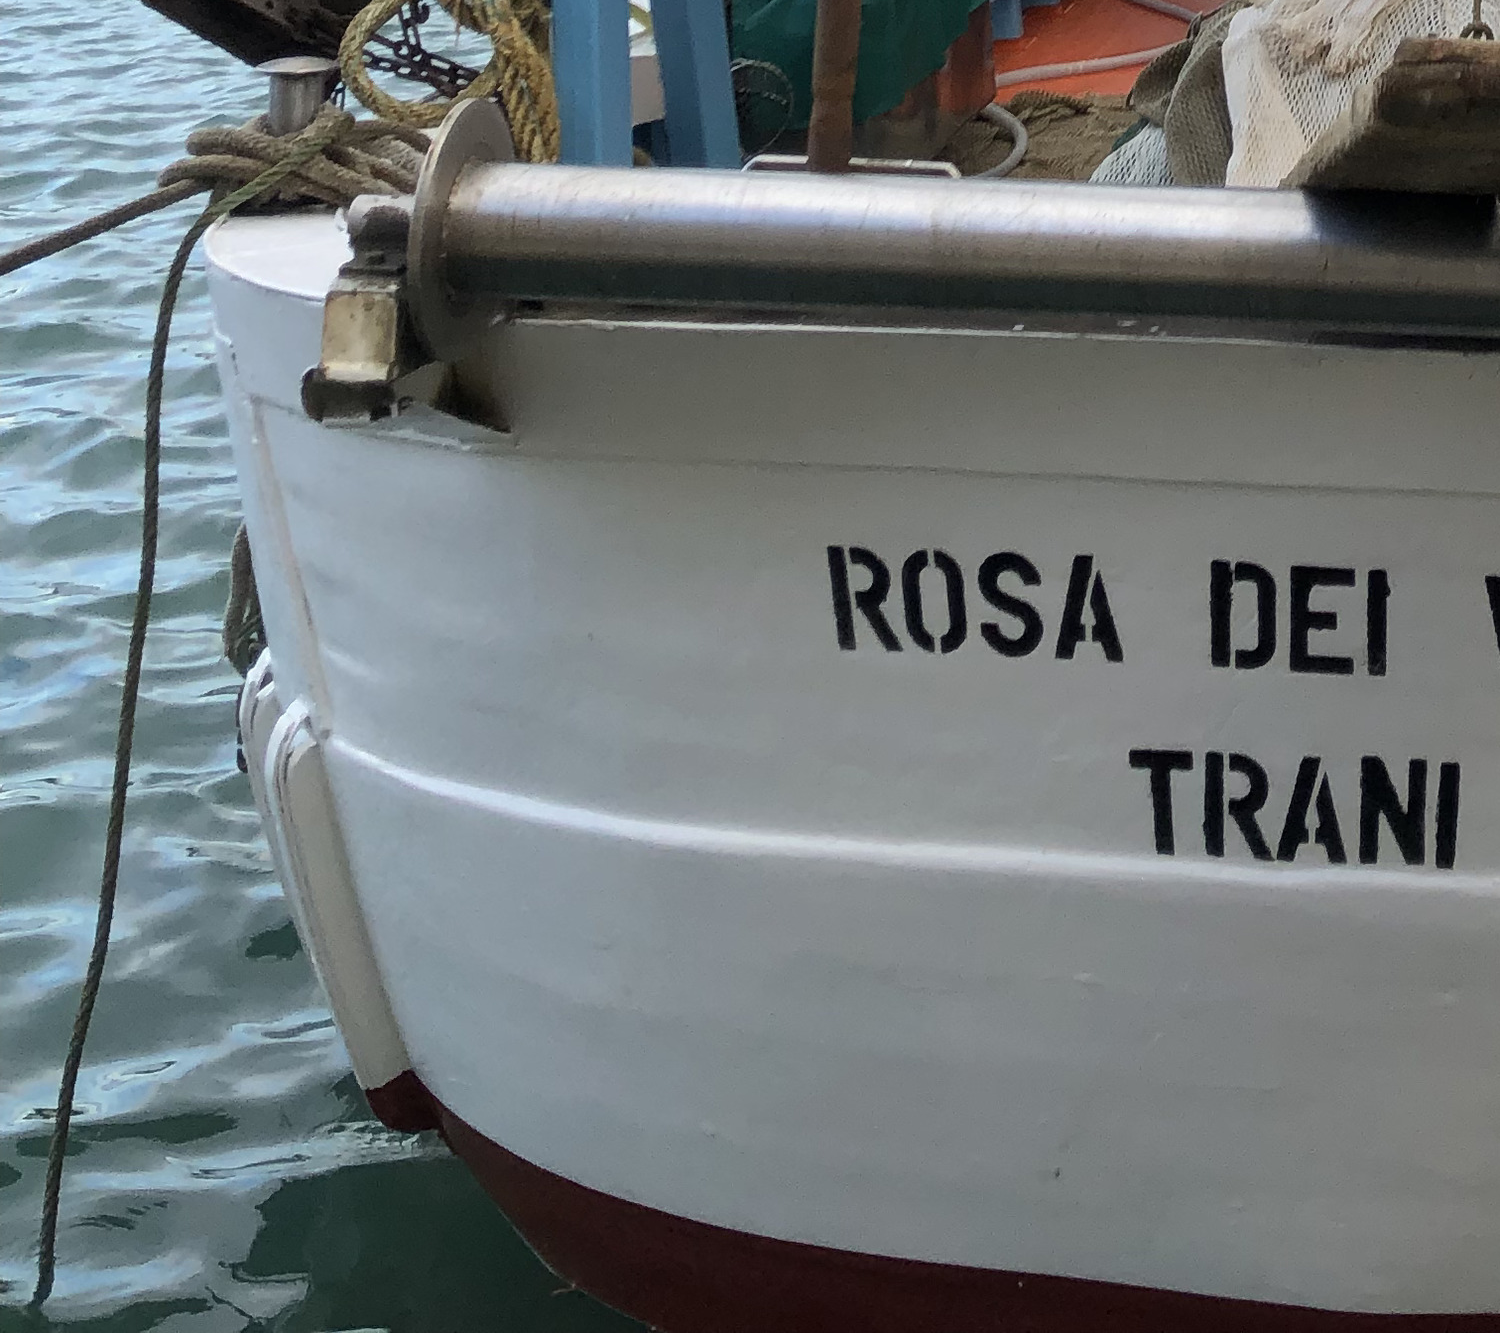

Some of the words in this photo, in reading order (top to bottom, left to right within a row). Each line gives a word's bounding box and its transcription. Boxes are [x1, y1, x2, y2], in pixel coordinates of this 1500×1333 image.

[826, 544, 1124, 663] ROSA
[1208, 558, 1393, 677] DEI
[1128, 747, 1462, 870] TRANI
